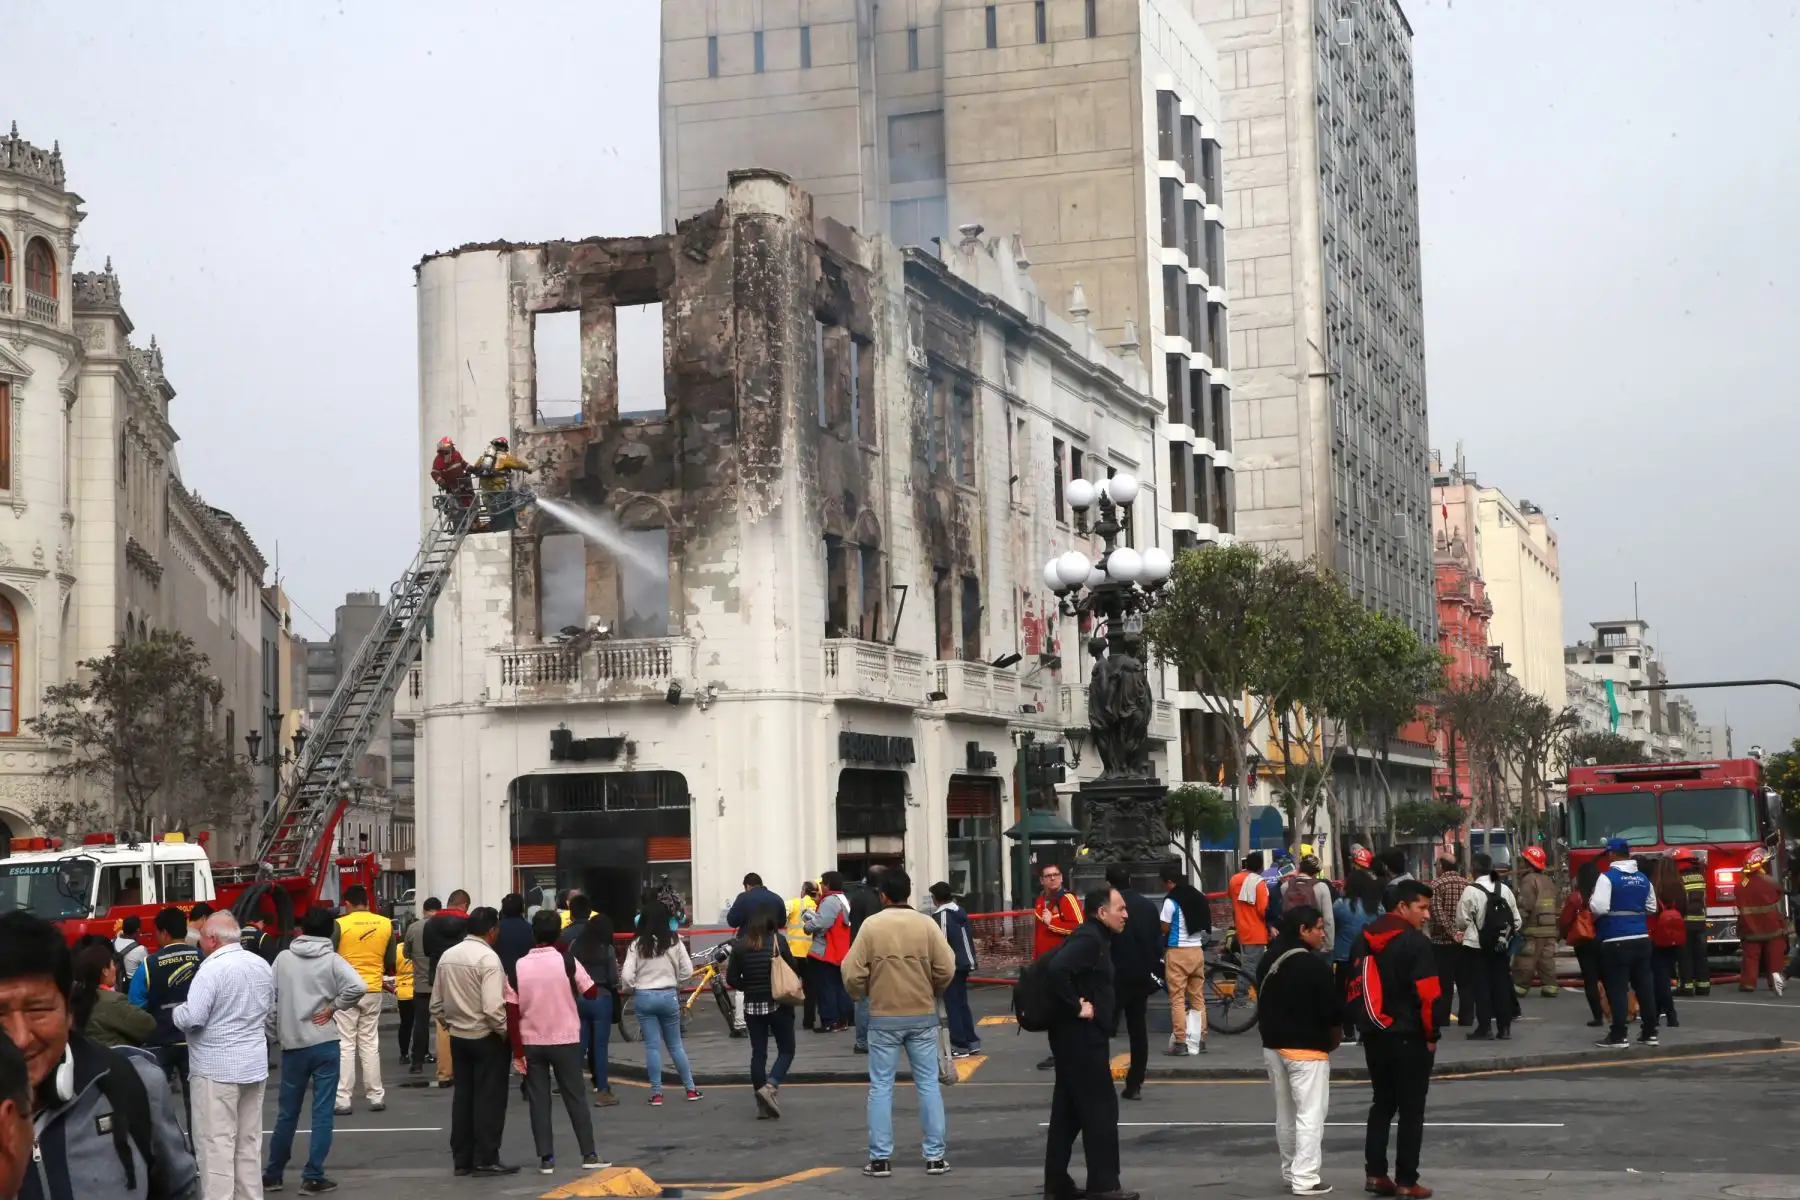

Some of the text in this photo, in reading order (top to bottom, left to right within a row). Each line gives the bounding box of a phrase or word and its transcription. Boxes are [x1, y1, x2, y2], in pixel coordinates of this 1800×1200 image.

[9, 867, 39, 875] ESCALA
[42, 866, 48, 874] B
[158, 956, 183, 967] DEFENSA
